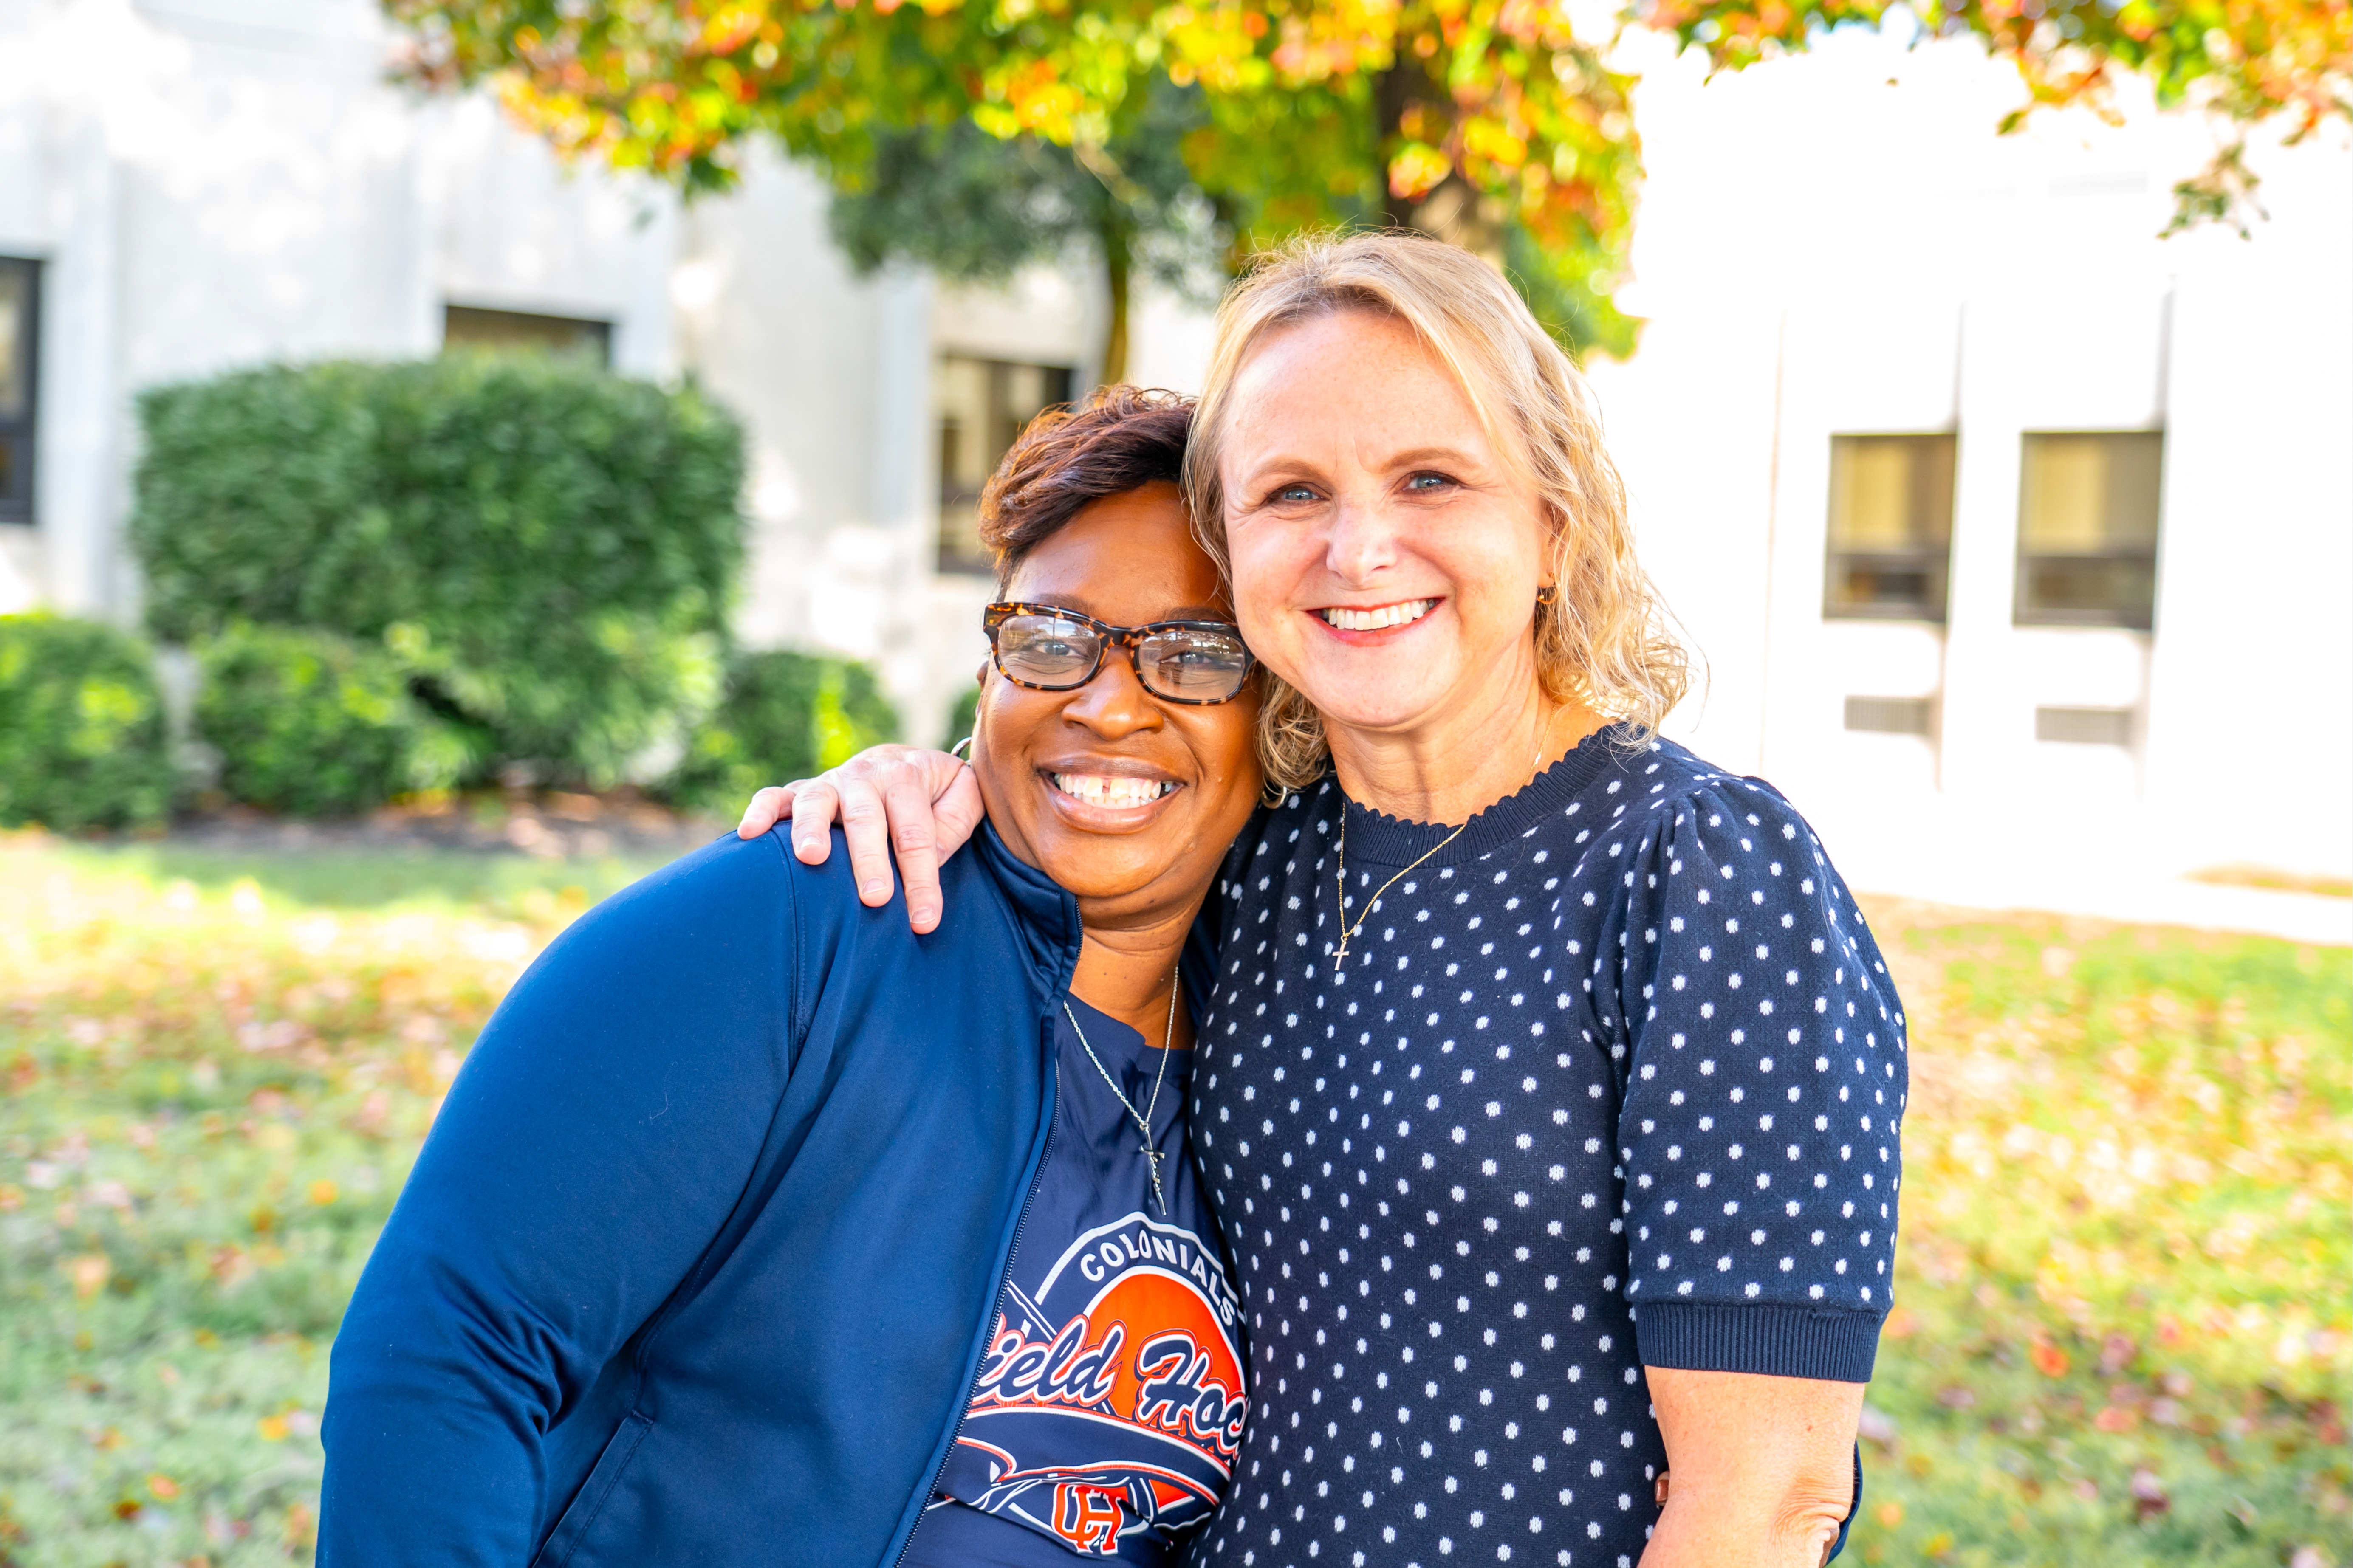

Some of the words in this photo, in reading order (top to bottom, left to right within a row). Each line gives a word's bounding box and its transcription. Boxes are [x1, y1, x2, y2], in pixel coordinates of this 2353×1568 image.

[1080, 1229, 1235, 1326] COLONIALS
[972, 1315, 1125, 1406] ield
[1137, 1330, 1247, 1458] Hoc
